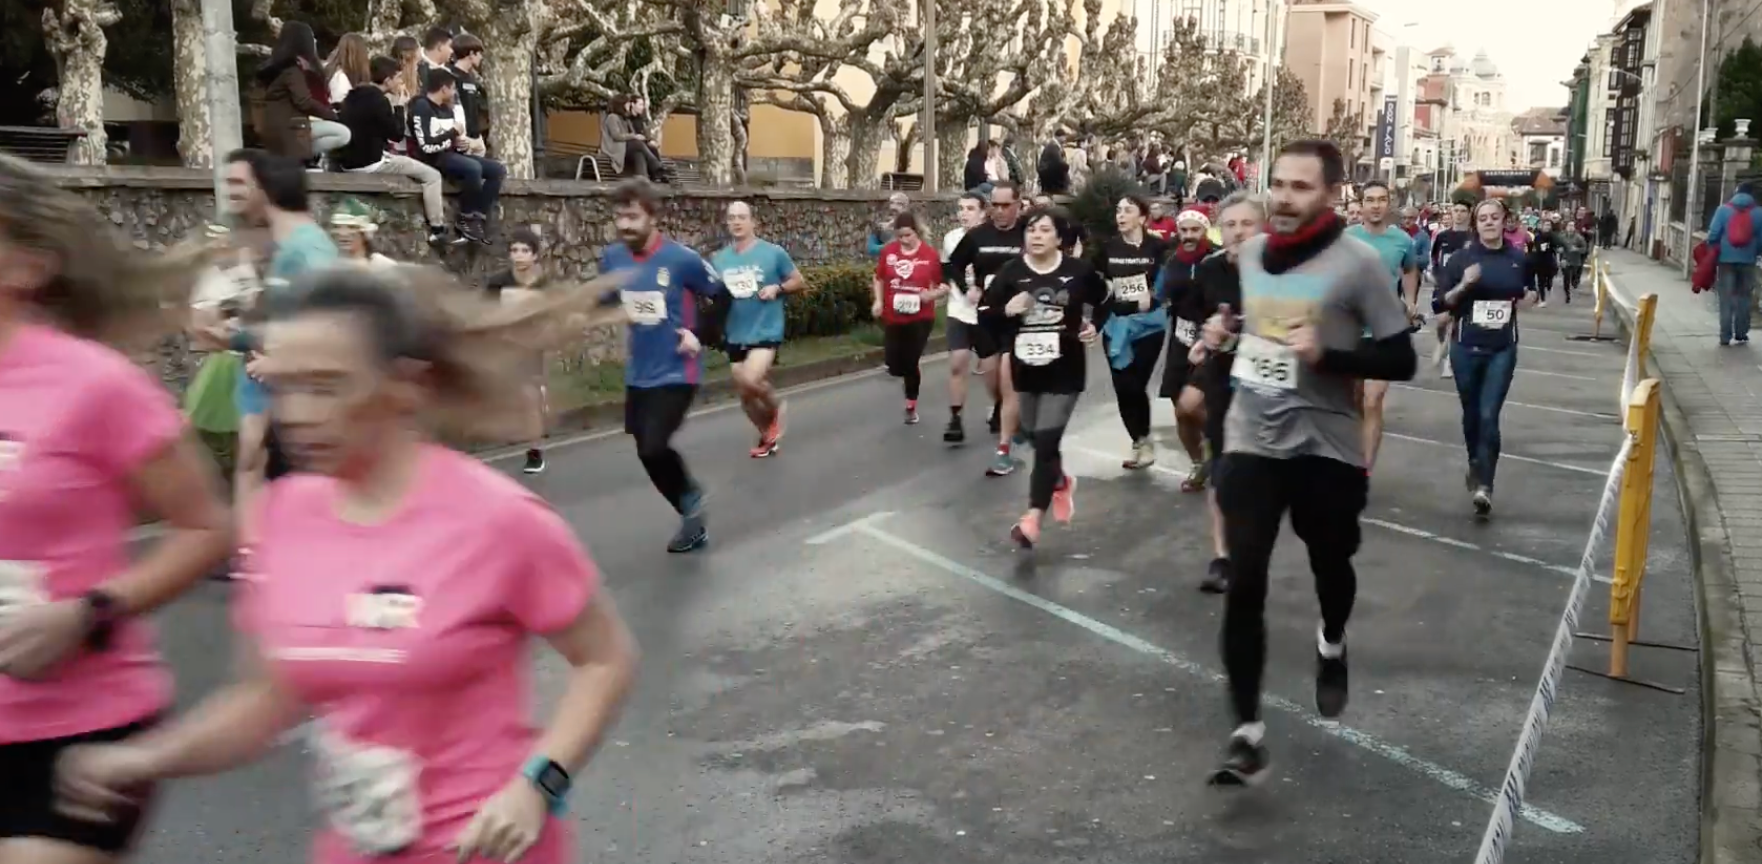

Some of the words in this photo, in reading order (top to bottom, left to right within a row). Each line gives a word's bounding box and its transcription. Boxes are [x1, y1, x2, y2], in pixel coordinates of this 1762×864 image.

[1121, 284, 1145, 295] 256
[1486, 309, 1504, 320] 50
[1026, 343, 1055, 356] 334
